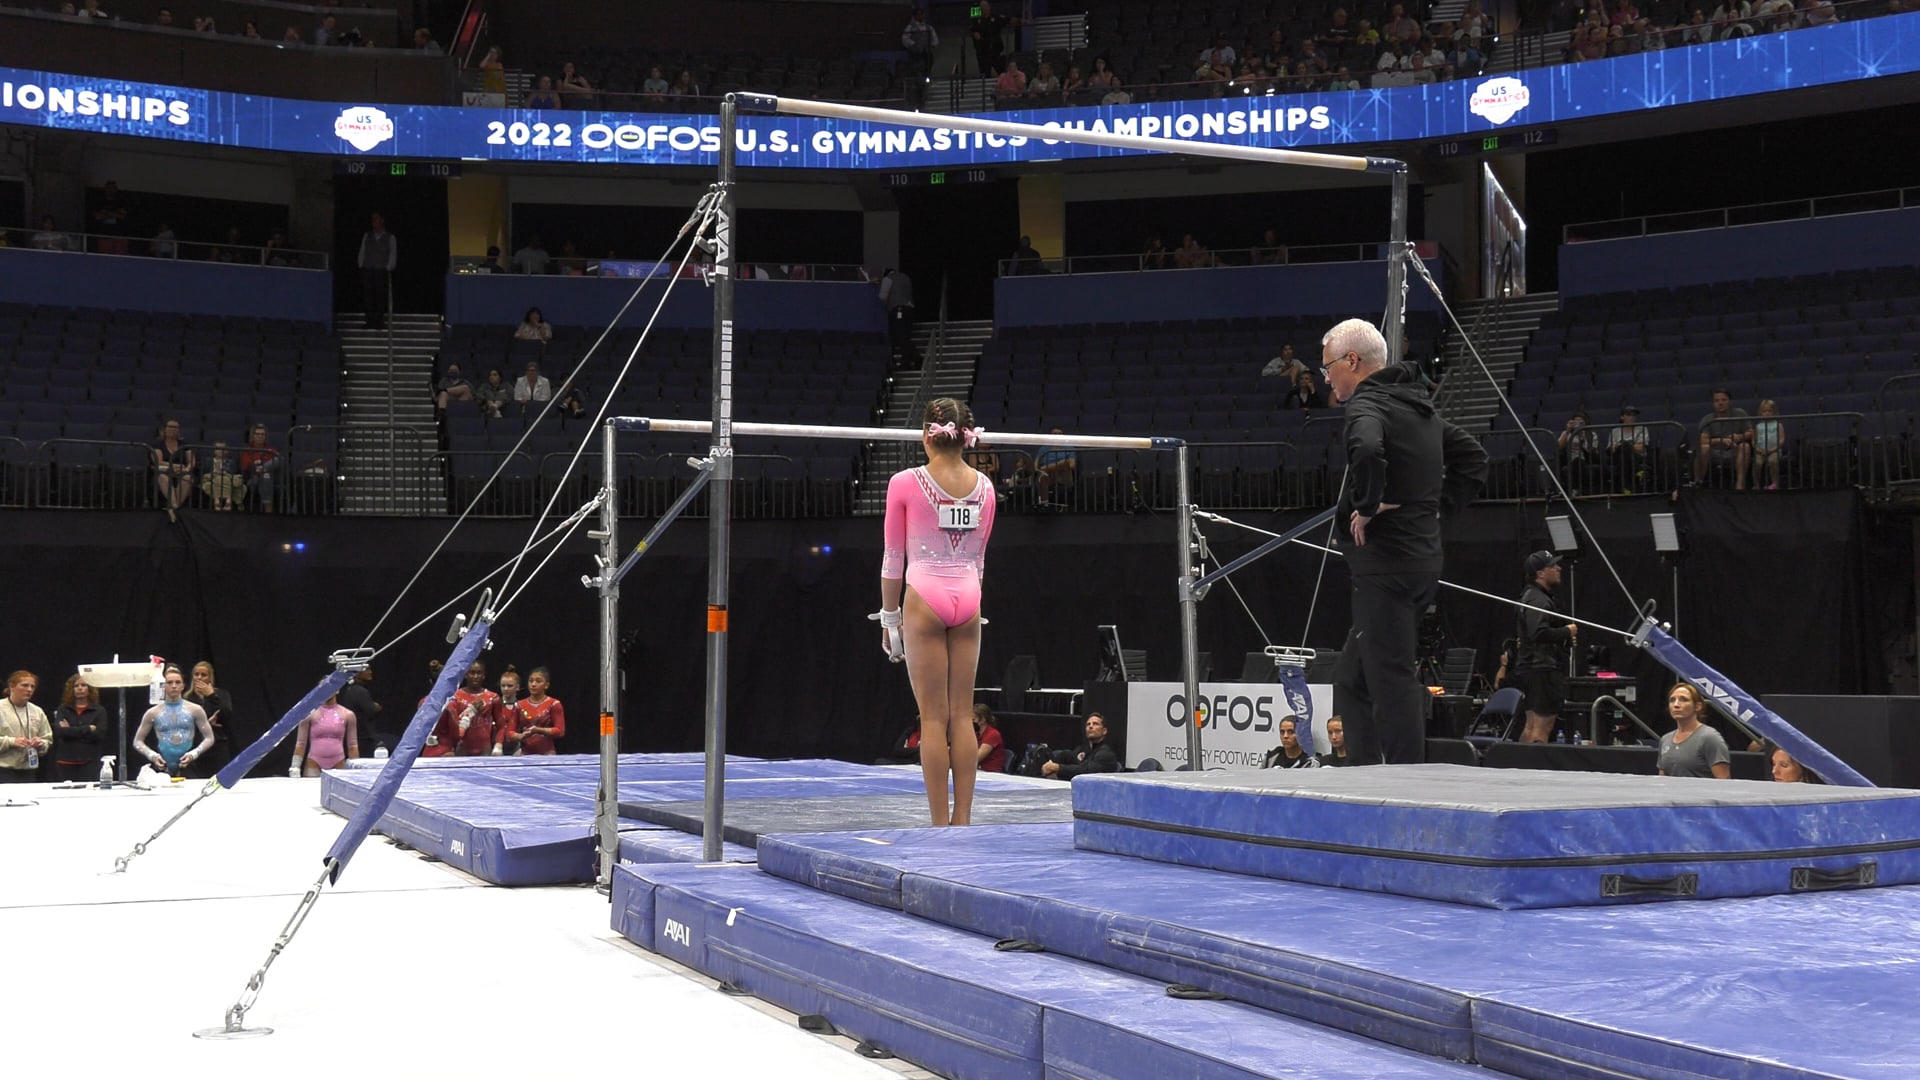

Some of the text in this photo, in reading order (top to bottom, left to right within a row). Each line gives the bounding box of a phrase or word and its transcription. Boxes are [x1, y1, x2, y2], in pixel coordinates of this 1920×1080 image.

[3, 82, 190, 126] IONSHIPS
[486, 121, 572, 147] 2022
[581, 123, 720, 152] OOFOS
[735, 128, 799, 153] U.S.
[1440, 142, 1458, 155] 110
[1523, 131, 1543, 144] 112
[950, 508, 971, 525] 118
[1164, 746, 1267, 767] RECORY FOOTWEA
